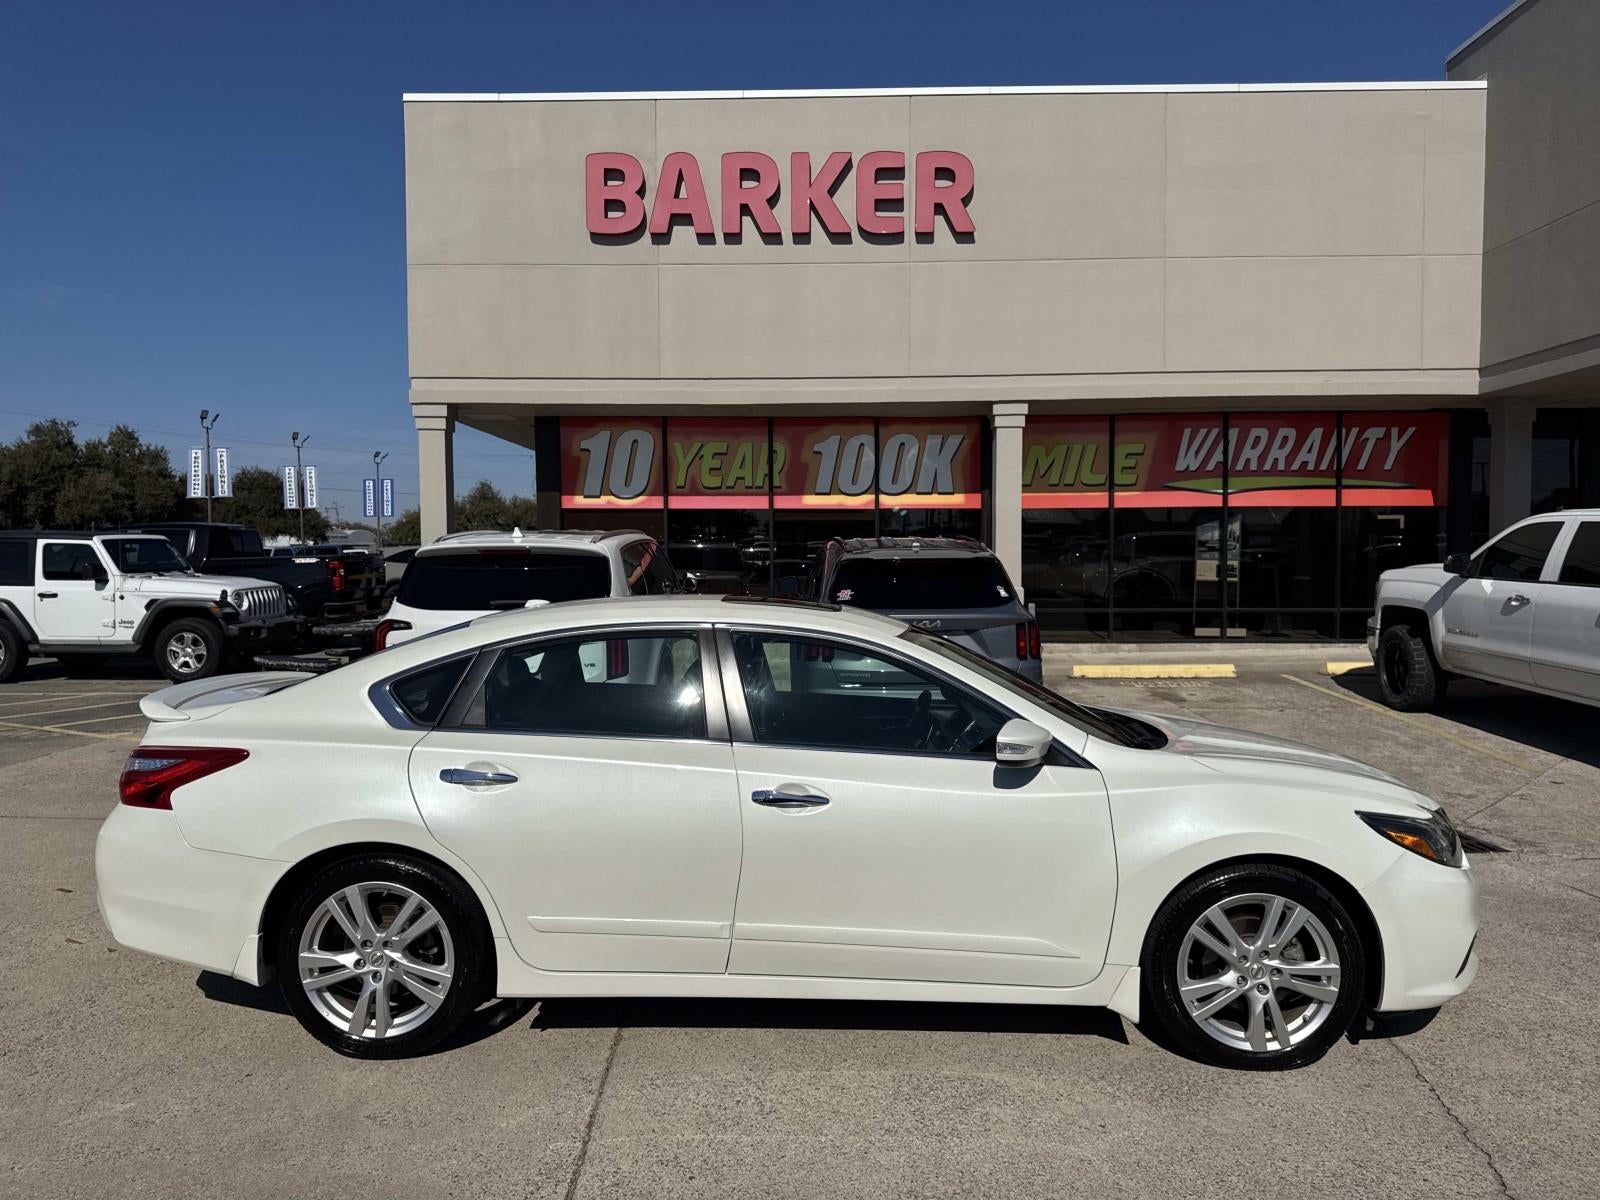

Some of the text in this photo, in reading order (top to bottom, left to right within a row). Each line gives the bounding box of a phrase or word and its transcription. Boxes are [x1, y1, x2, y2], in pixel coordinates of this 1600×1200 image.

[586, 150, 976, 235] BARKER
[192, 451, 200, 496] TERREBONNE
[579, 426, 1417, 499] 10 YEAR 100K MILE WARRANTY
